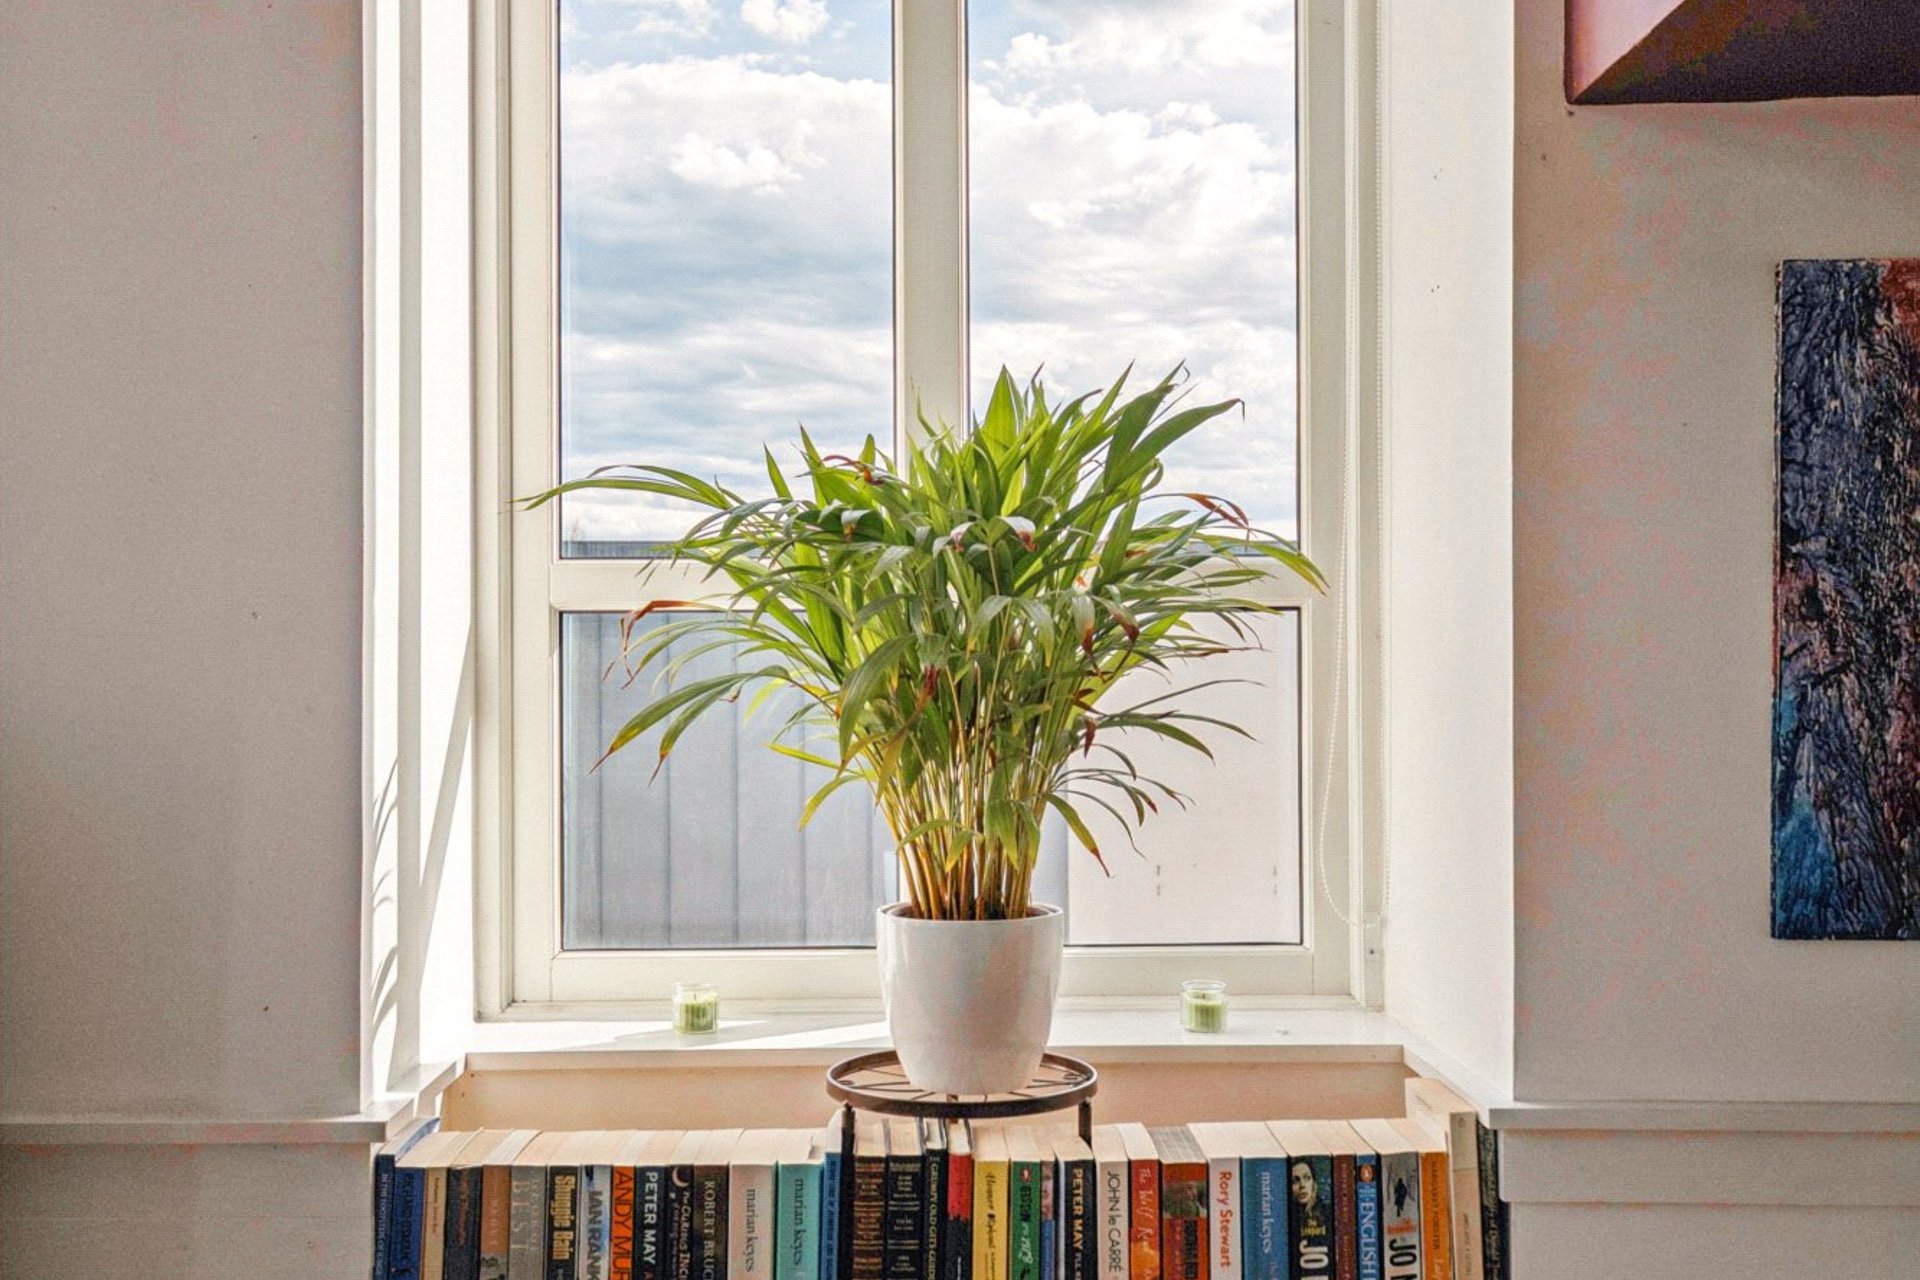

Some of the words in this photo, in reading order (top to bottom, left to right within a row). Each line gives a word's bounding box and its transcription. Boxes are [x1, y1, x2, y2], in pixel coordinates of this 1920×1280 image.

[1073, 1168, 1083, 1215] PETER
[1108, 1171, 1121, 1212] JOHN
[1139, 1168, 1150, 1184] The
[1216, 1171, 1232, 1206] Rory
[1261, 1171, 1274, 1216] marian
[510, 1179, 530, 1250] BEST
[549, 1175, 577, 1228] Shuggie
[588, 1190, 602, 1223] IAN
[613, 1170, 633, 1230] ANDY
[644, 1171, 658, 1224] PETER
[703, 1180, 717, 1236] ROBERT
[746, 1188, 758, 1233] marian
[794, 1178, 807, 1225] marian
[1073, 1218, 1084, 1249] MAY
[1108, 1214, 1122, 1225] le
[1220, 1209, 1233, 1267] Stewart
[1260, 1218, 1275, 1254] keyes
[1360, 1202, 1377, 1271] ENGLISH
[552, 1231, 575, 1260] Bain
[643, 1229, 656, 1265] MAY
[702, 1240, 715, 1280] BRUC
[743, 1236, 758, 1273] keyes
[791, 1229, 807, 1266] keyes
[1108, 1228, 1125, 1272] CARRÉ
[1299, 1239, 1329, 1269] JO
[1388, 1238, 1417, 1267] JO
